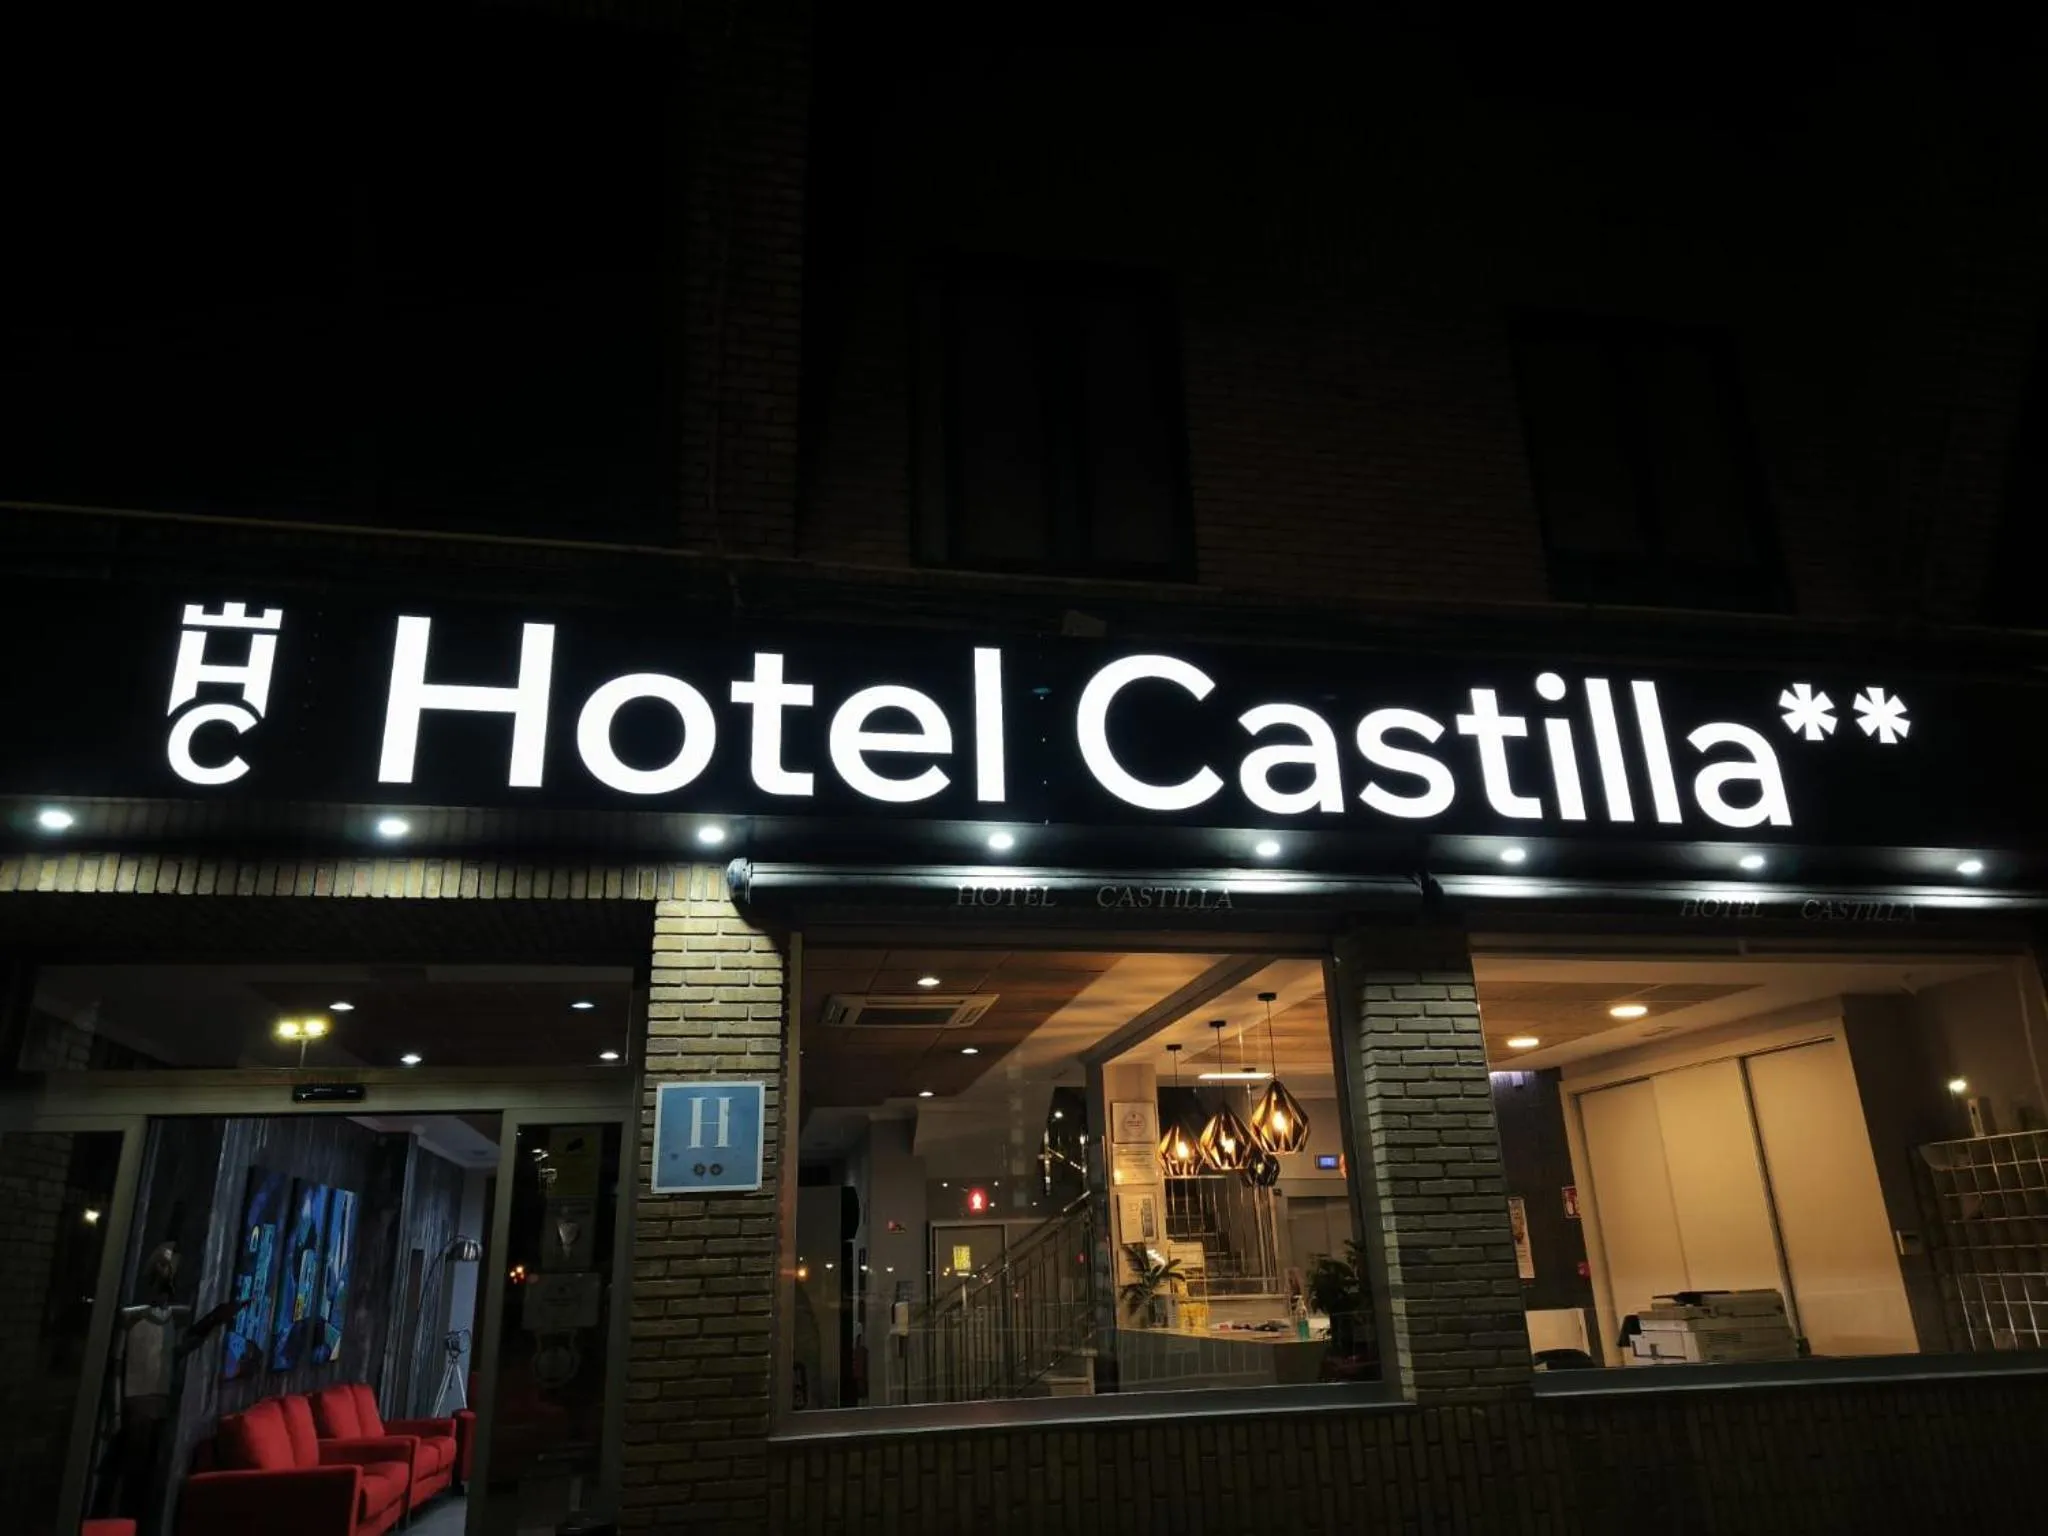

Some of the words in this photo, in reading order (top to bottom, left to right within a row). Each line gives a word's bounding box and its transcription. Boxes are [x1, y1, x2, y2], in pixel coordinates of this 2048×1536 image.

[377, 614, 1006, 802] Hotel
[956, 885, 1057, 907] HOTEL
[1097, 886, 1234, 909] CASTILLA
[1679, 897, 1764, 918] HOTEL
[1801, 898, 1917, 922] CASTILLA
[686, 1096, 734, 1150] H
